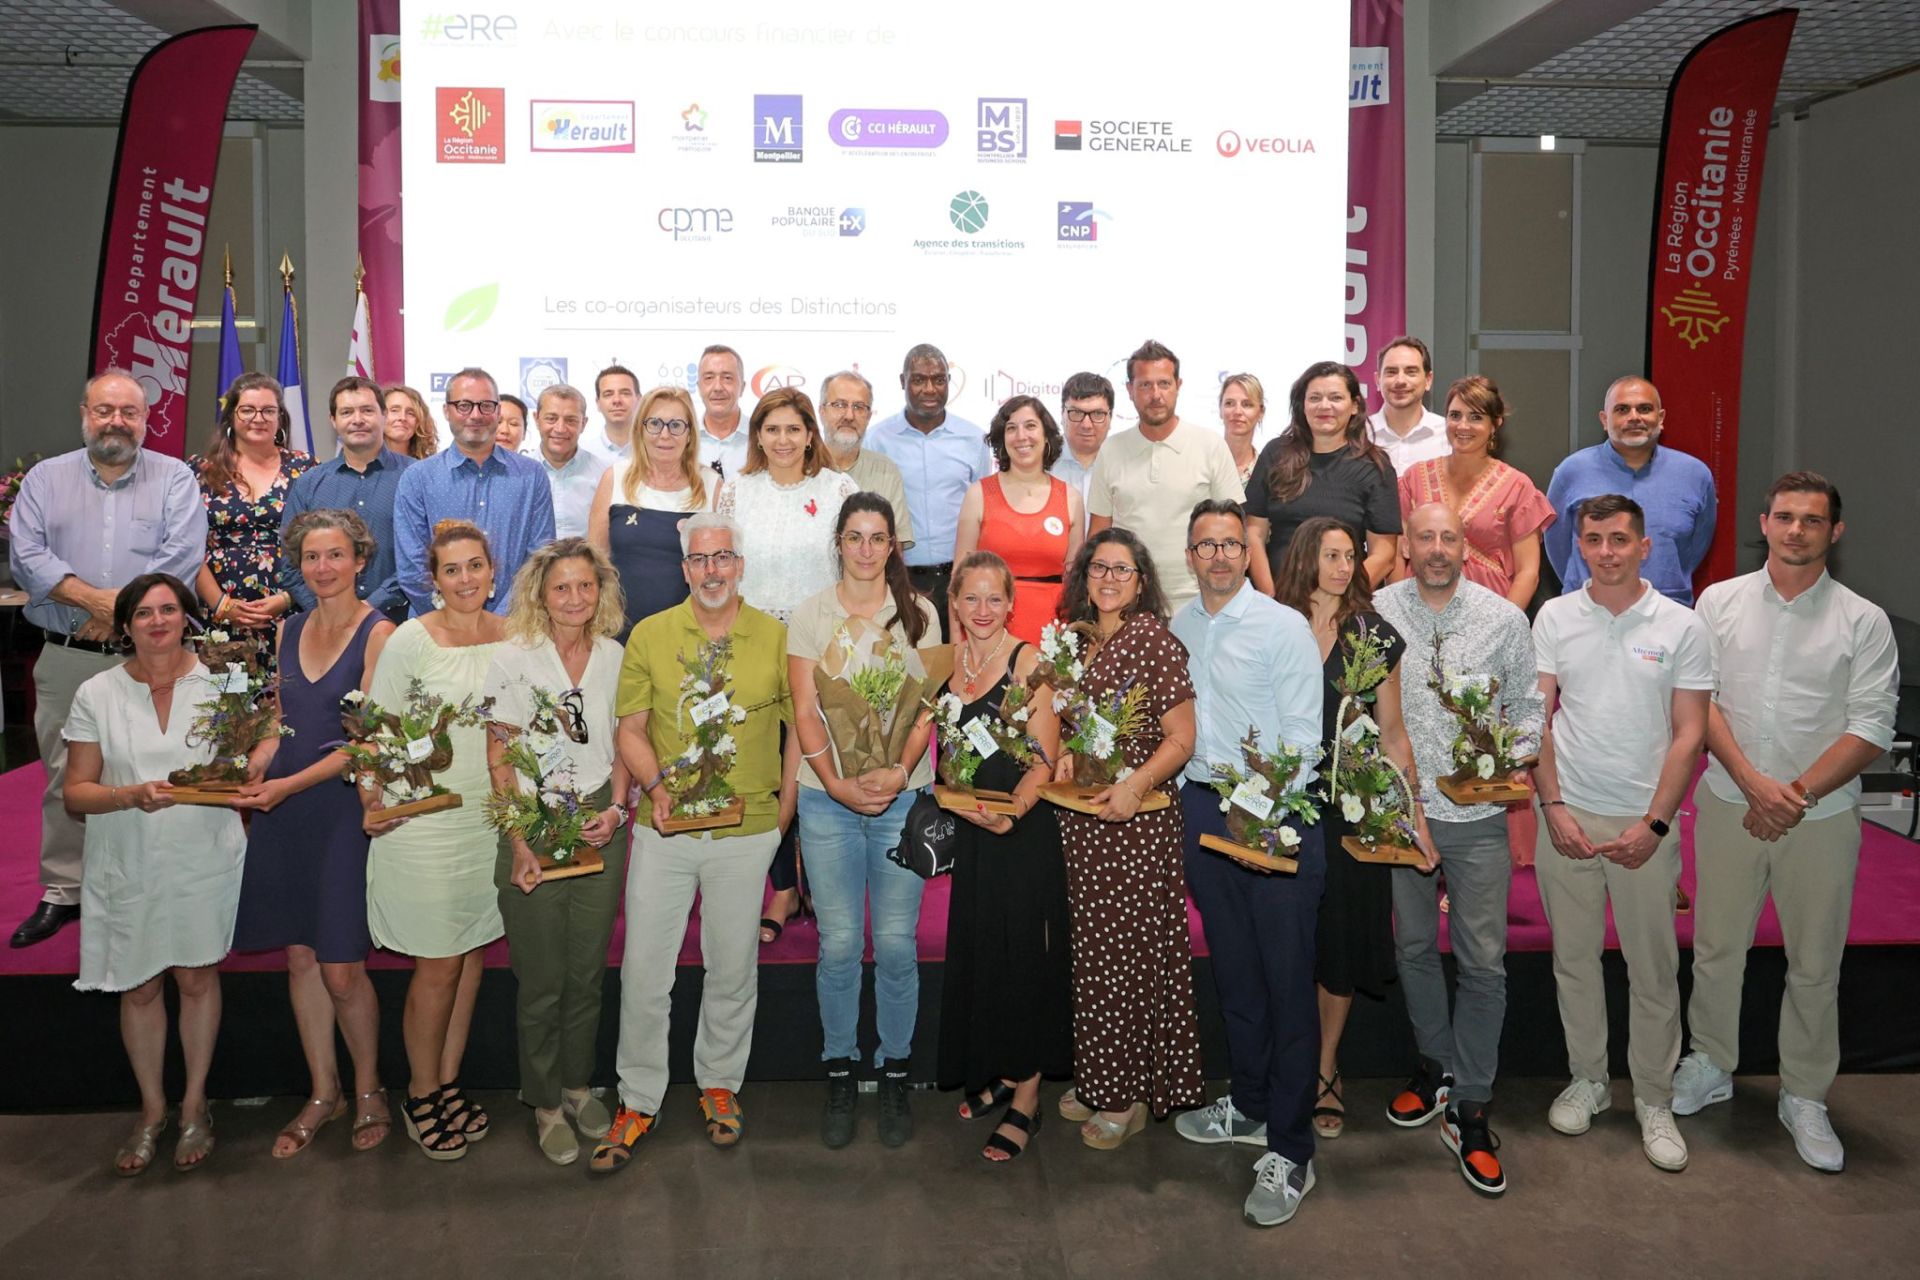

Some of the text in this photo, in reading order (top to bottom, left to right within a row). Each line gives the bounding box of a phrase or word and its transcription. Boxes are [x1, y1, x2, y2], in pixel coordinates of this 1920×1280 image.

[543, 19, 897, 45] Avec le concours financier de
[868, 120, 936, 135] CCI HÉRAULT
[1089, 120, 1173, 136] SOCIETE
[443, 144, 498, 155] Occitanie
[1089, 137, 1193, 153] GENERALE
[1245, 138, 1316, 154] VEOLIA
[1732, 108, 1758, 204] Méditerranée
[1685, 106, 1734, 278] Occitanie
[787, 206, 836, 217] BANQUE
[657, 207, 734, 242] cpme
[771, 216, 836, 227] POPULAIRE
[1665, 181, 1690, 274] La Région
[124, 165, 157, 305] Departement
[1060, 224, 1091, 238] CNP
[913, 239, 1025, 250] Agence des transitions
[1723, 214, 1743, 281] Pyrénées
[545, 296, 897, 319] Les co-organisateurs des Distinctions
